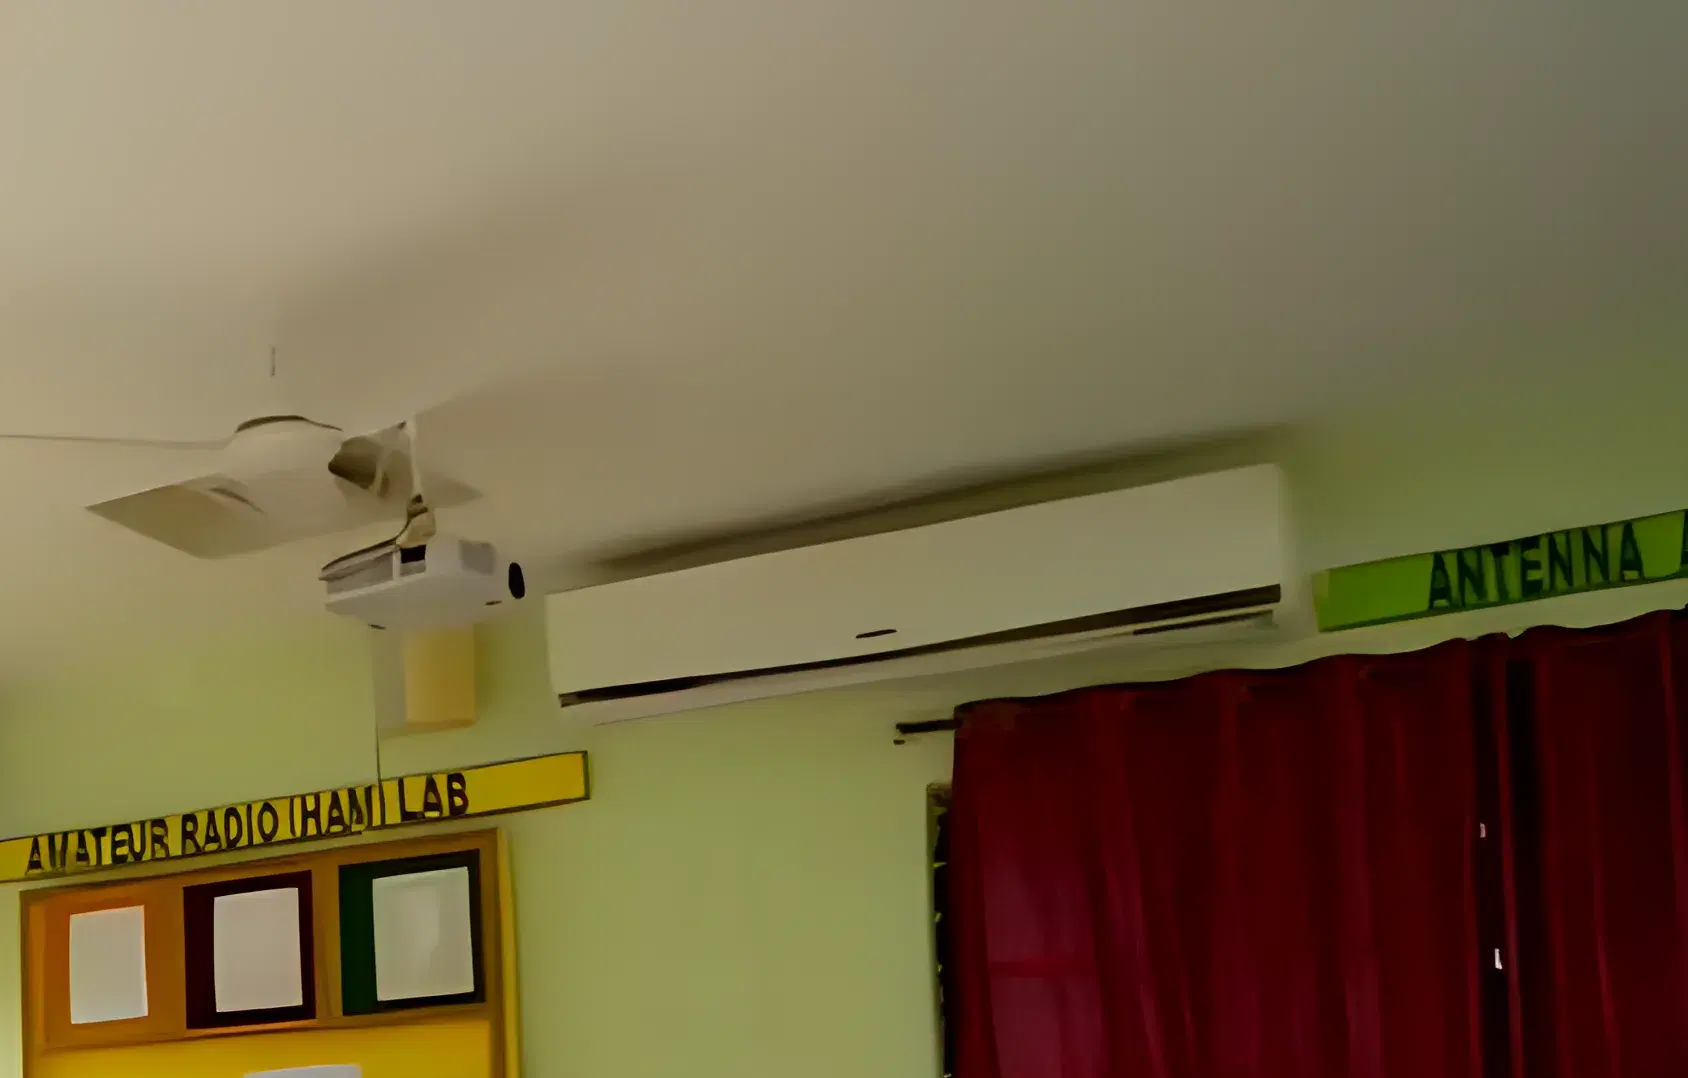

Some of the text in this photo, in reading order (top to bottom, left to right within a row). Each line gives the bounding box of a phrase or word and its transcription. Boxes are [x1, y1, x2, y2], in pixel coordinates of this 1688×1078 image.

[1428, 522, 1645, 610] ANTENNA
[25, 819, 170, 875] AMATEUR
[181, 801, 278, 854] RADIO
[397, 772, 468, 820] LAB
